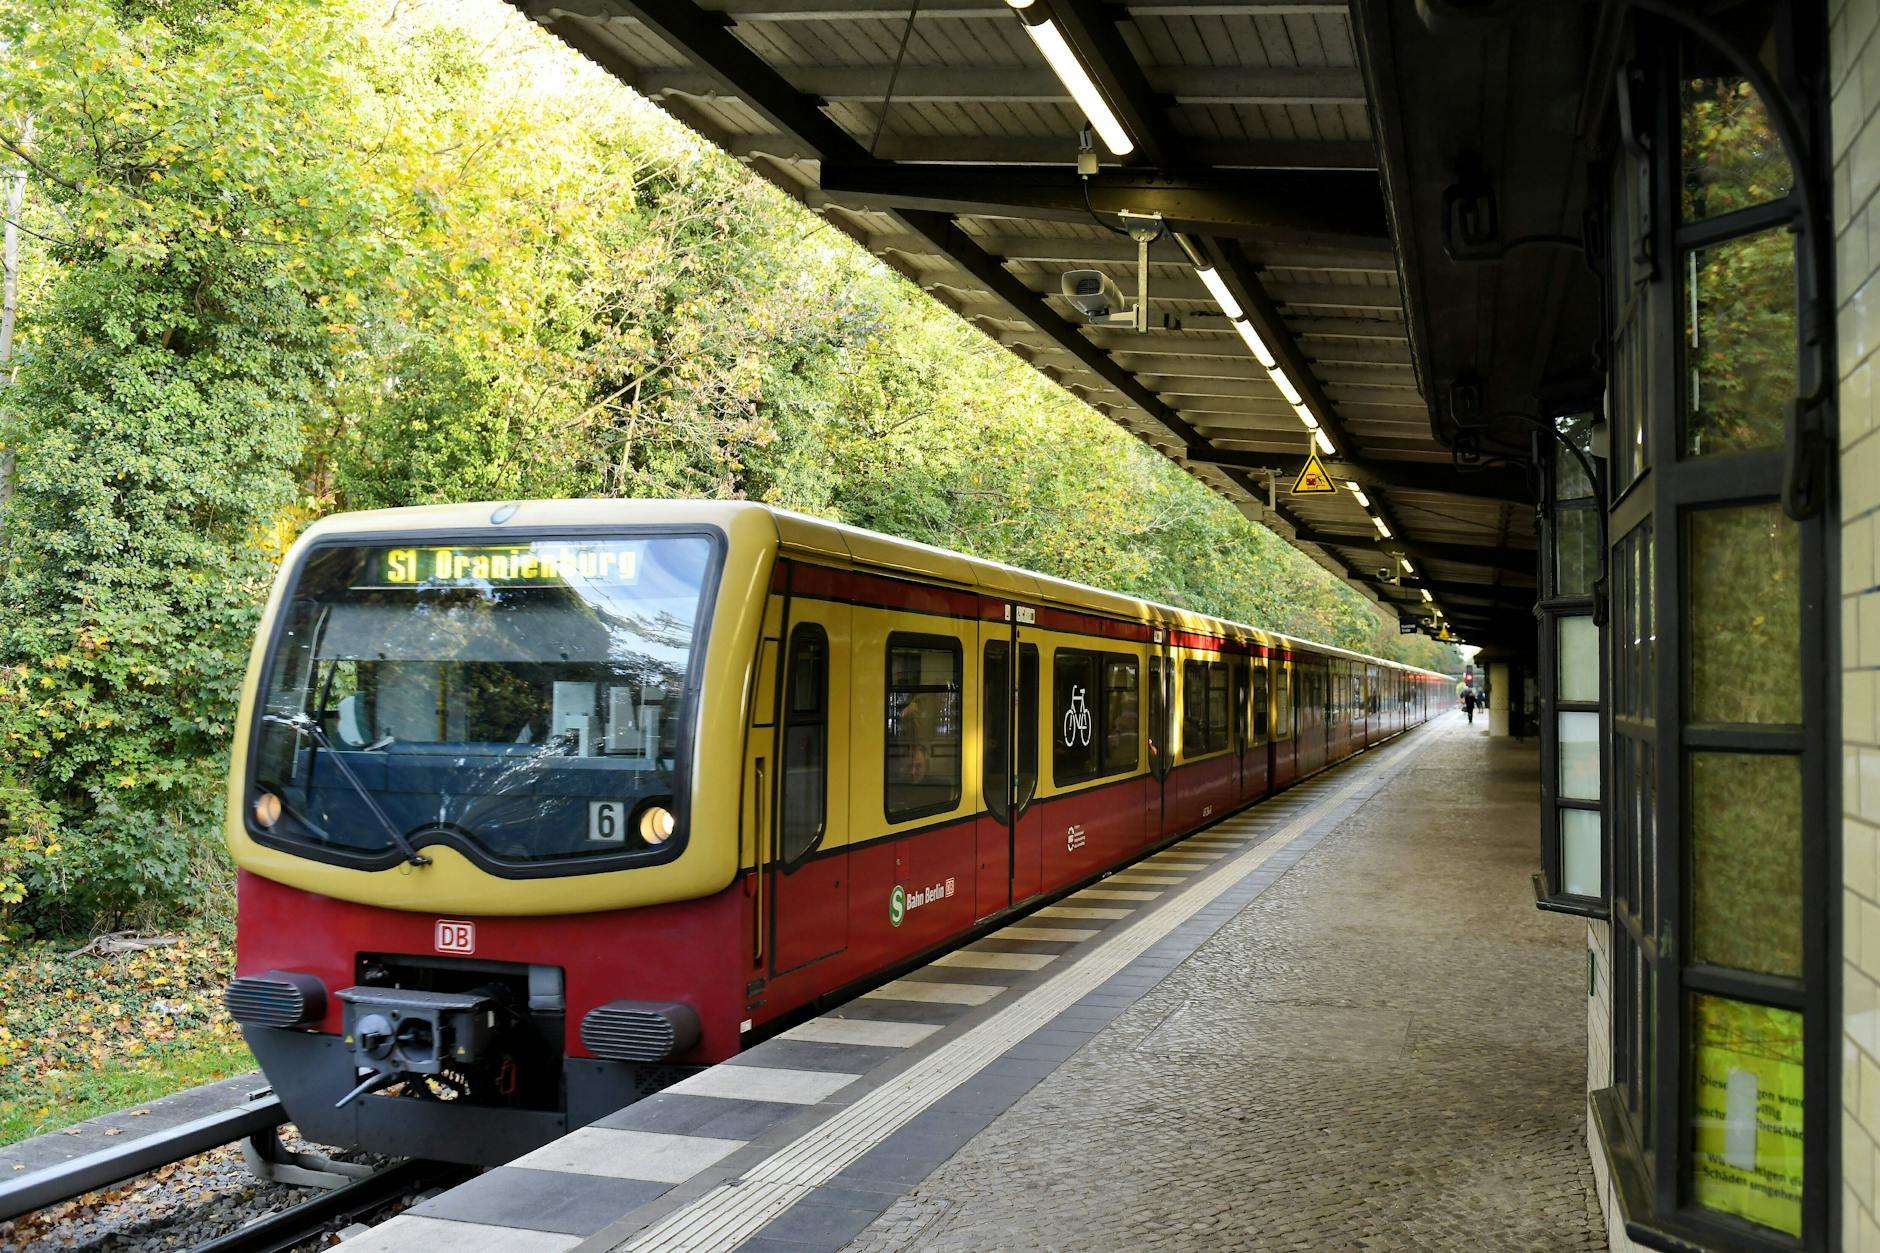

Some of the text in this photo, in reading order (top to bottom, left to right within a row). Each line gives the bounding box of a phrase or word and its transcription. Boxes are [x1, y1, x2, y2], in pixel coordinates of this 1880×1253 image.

[387, 549, 638, 583] S1 Oranienburg
[597, 804, 615, 838] 6
[906, 891, 924, 911] Bahn
[924, 883, 945, 904] Berlin
[439, 923, 471, 950] DB
